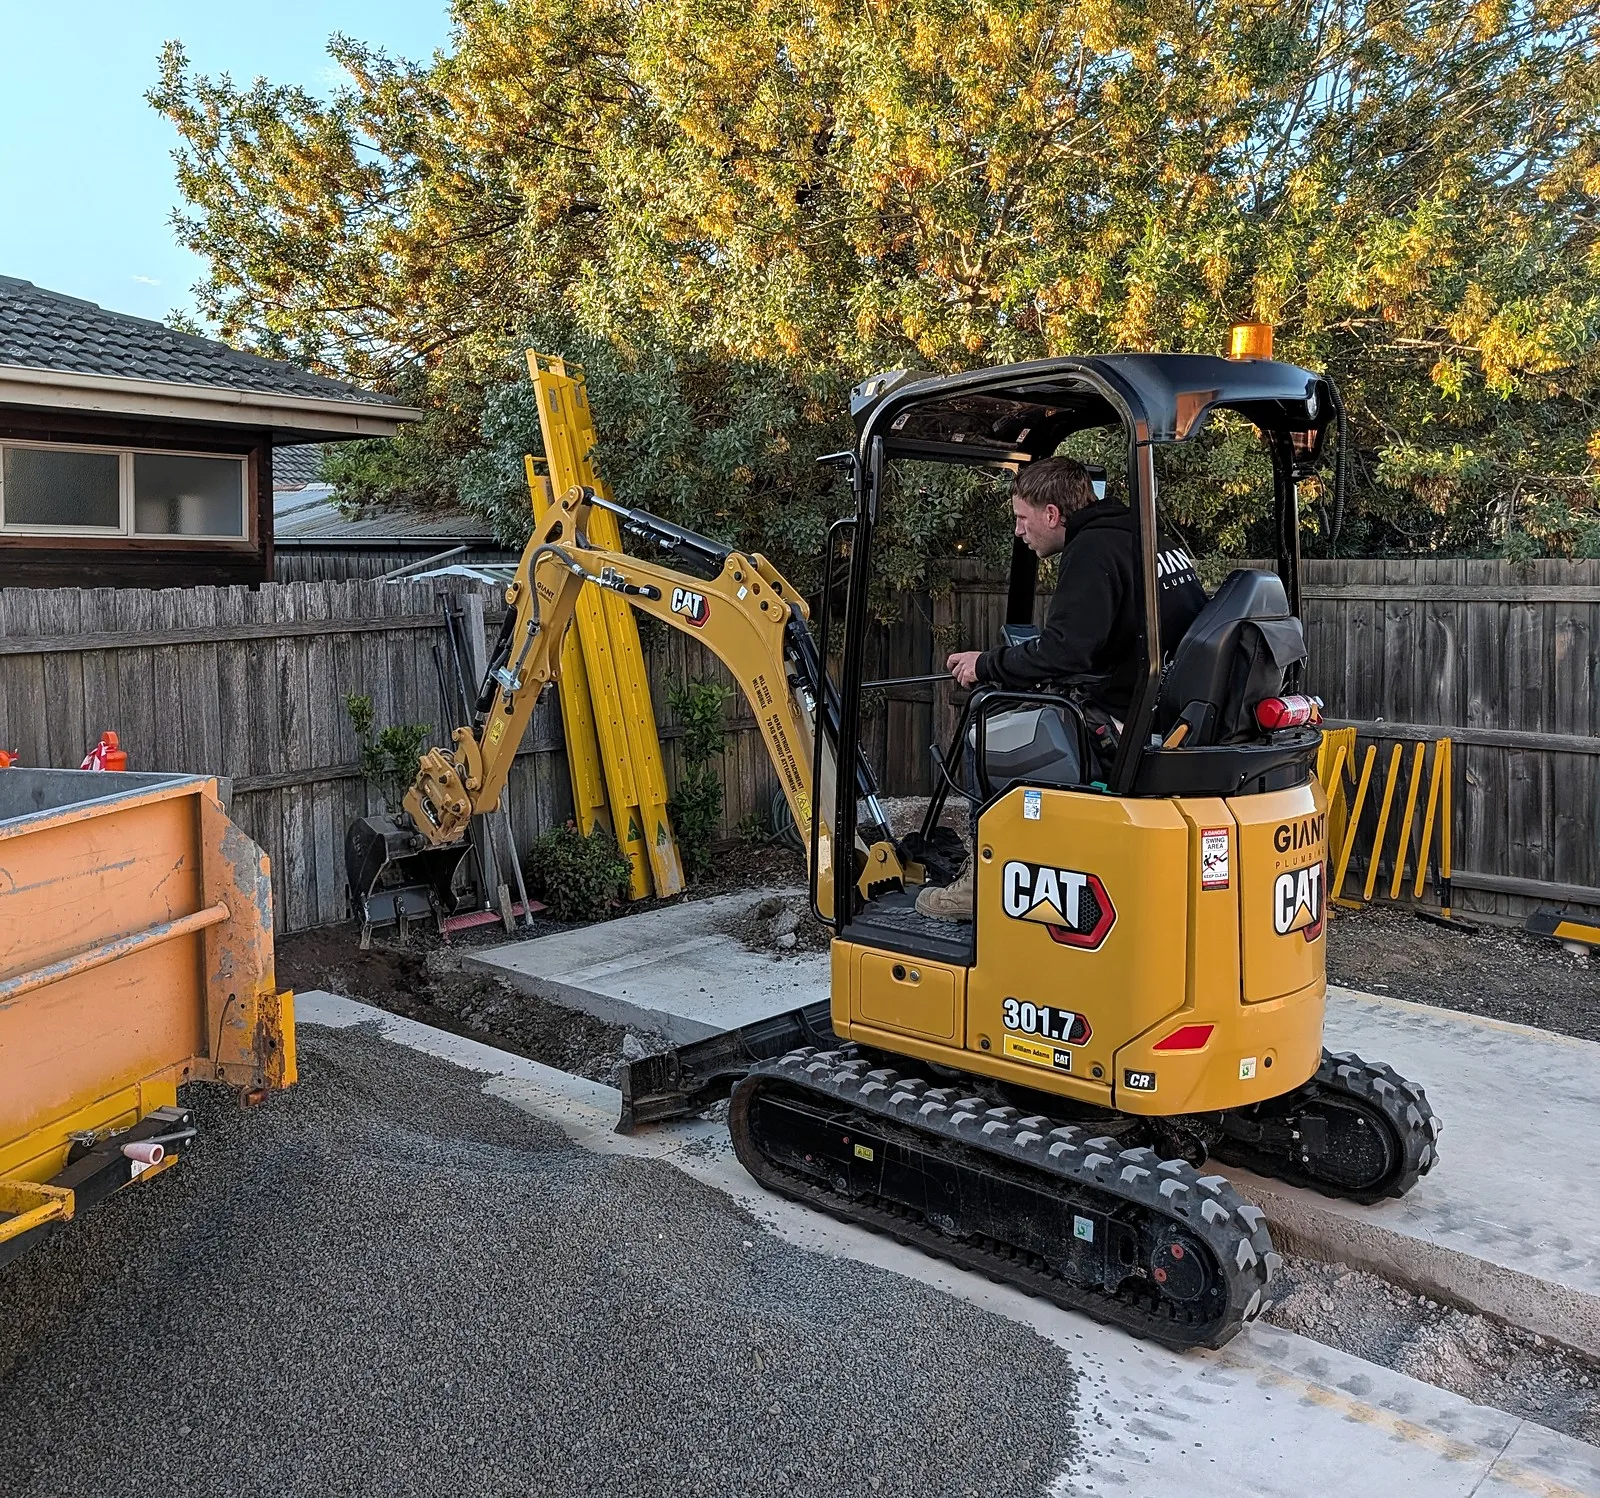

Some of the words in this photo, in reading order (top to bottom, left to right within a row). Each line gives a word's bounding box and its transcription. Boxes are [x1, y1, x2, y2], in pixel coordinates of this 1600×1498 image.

[1157, 547, 1193, 578] IAN
[536, 581, 555, 599] GIANT
[671, 587, 703, 619] CAT
[756, 689, 767, 710] MOBILE
[762, 685, 773, 705] STATIC
[772, 733, 785, 758] WITHOUT
[780, 758, 798, 793] ATTACHMENT
[778, 730, 791, 754] WITHOUT
[787, 754, 804, 790] ATTACHMENT
[1206, 837, 1226, 845] SWING
[1273, 812, 1325, 853] GIANT
[1275, 846, 1325, 869] PLUMBING
[1004, 861, 1087, 929] CAT
[1275, 863, 1320, 934] CAT
[1003, 998, 1075, 1041] 301.7
[1012, 1043, 1032, 1055] William
[1032, 1049, 1050, 1060] Adams
[1054, 1052, 1070, 1066] CAT
[1129, 1073, 1150, 1088] CR
